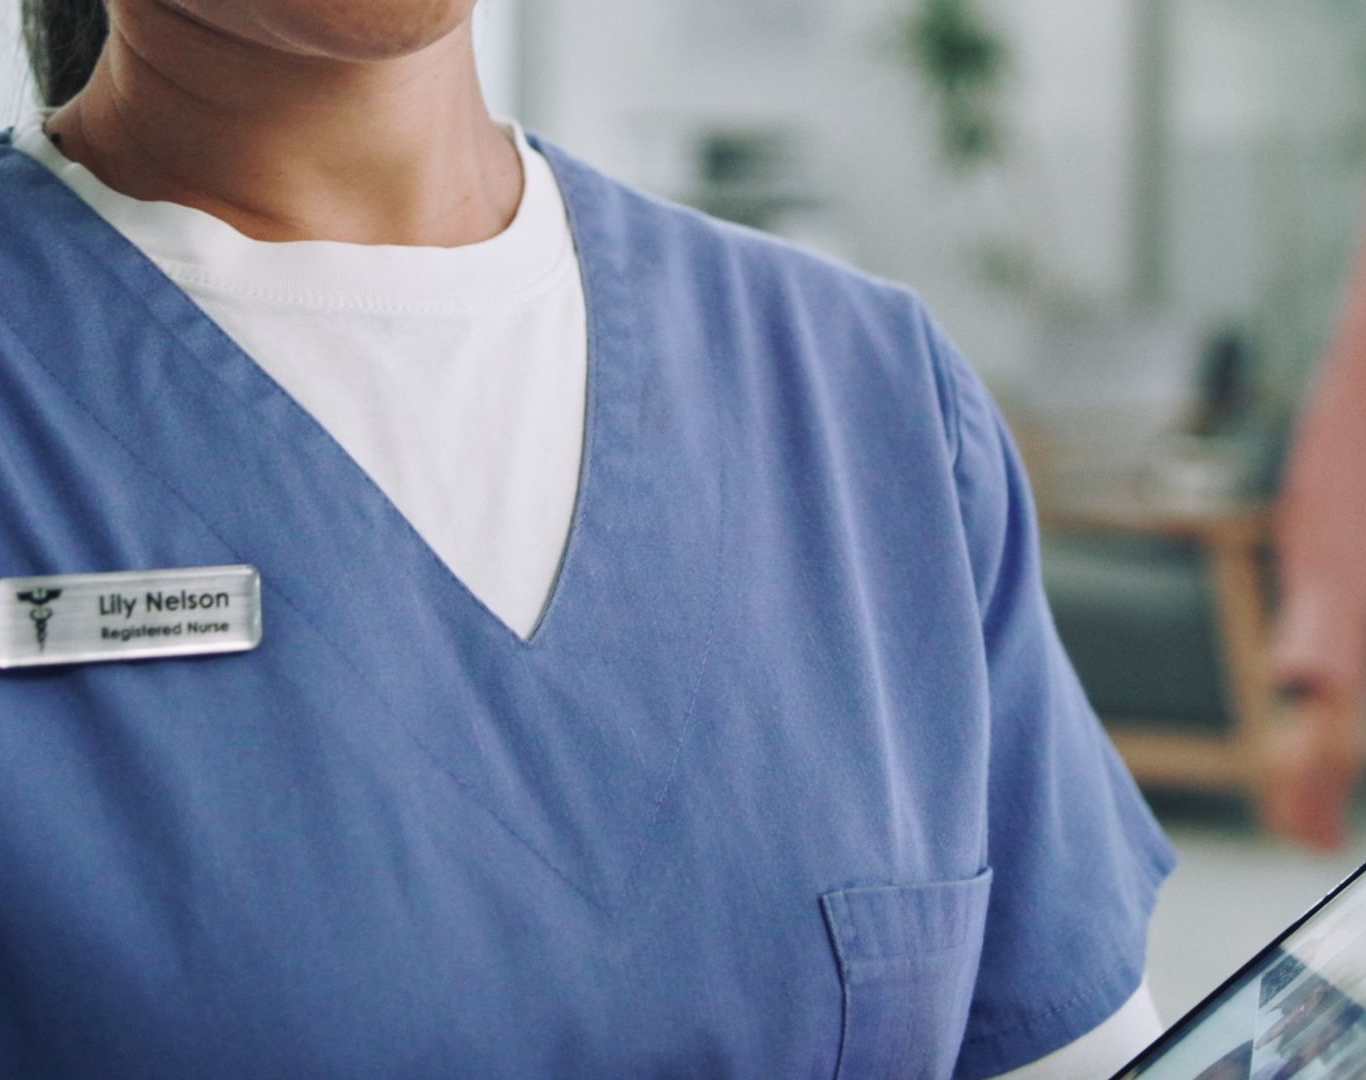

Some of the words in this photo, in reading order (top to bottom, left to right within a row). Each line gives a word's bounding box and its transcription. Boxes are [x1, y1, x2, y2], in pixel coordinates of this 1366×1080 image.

[99, 593, 137, 619] Lily
[146, 590, 229, 612] Nelson
[101, 623, 182, 641] Registered
[188, 621, 229, 634] Nurse
